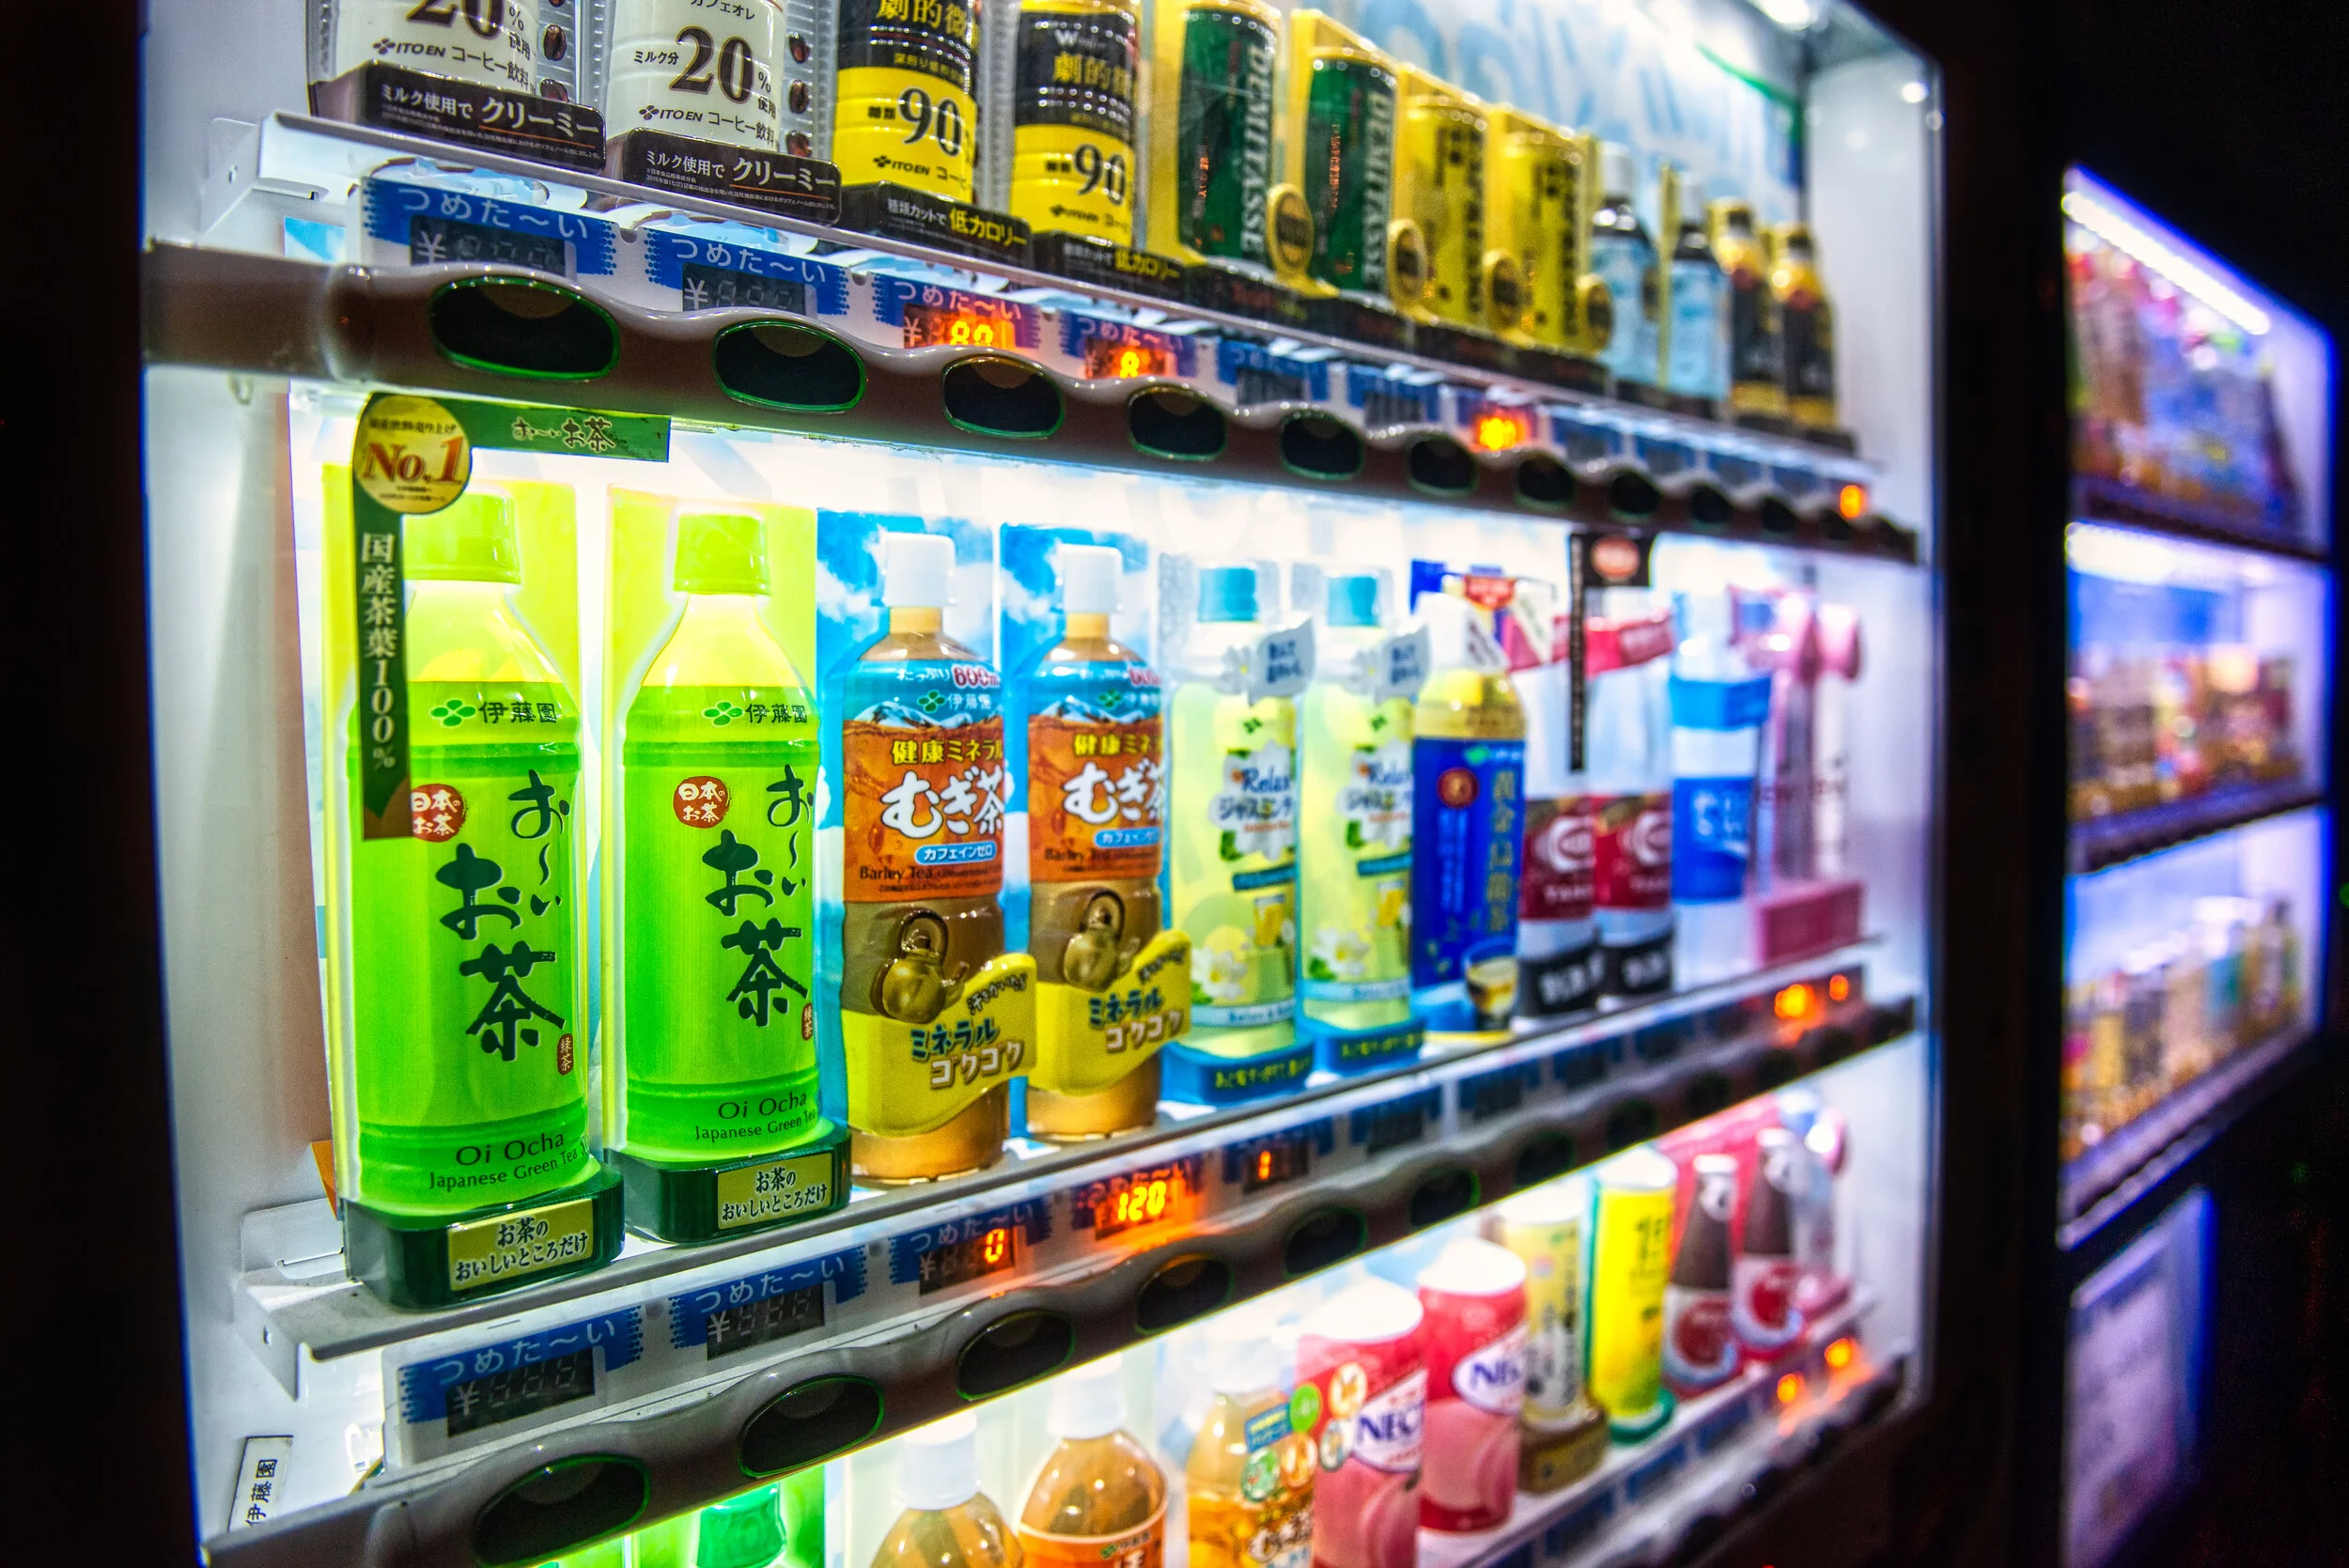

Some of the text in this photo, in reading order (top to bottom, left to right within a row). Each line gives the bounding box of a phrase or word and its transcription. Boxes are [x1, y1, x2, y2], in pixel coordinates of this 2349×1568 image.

[633, 51, 679, 66] ミルク分
[668, 24, 755, 105] 20
[481, 96, 600, 138] クリーミー
[897, 85, 963, 158] 90
[646, 149, 836, 192] ミルク使用で クリーミー
[1073, 144, 1127, 207] 90
[949, 207, 1028, 247] 低カロリー
[361, 435, 464, 485] No.1
[478, 701, 557, 725] 伊藤園
[745, 702, 808, 724] 伊藤園
[681, 802, 721, 824] お茶
[879, 765, 1004, 840] むぎ茶
[910, 1017, 999, 1061] ミネラル
[930, 1040, 1023, 1089] ゴクゴク
[717, 1091, 808, 1120] Oi Ocha
[455, 1144, 492, 1166] Oi
[504, 1131, 565, 1160] Ocha
[694, 1125, 762, 1143] Japanese
[767, 1118, 802, 1134] Green
[429, 1147, 579, 1193] Japanese Green Tea
[754, 1166, 798, 1194] お茶の
[721, 1183, 829, 1222] おいしいところだけ
[1117, 1180, 1167, 1222] 120
[496, 1216, 549, 1249] お茶の
[455, 1232, 589, 1283] おいしいところだけ
[244, 1458, 279, 1527] 伊藤園
